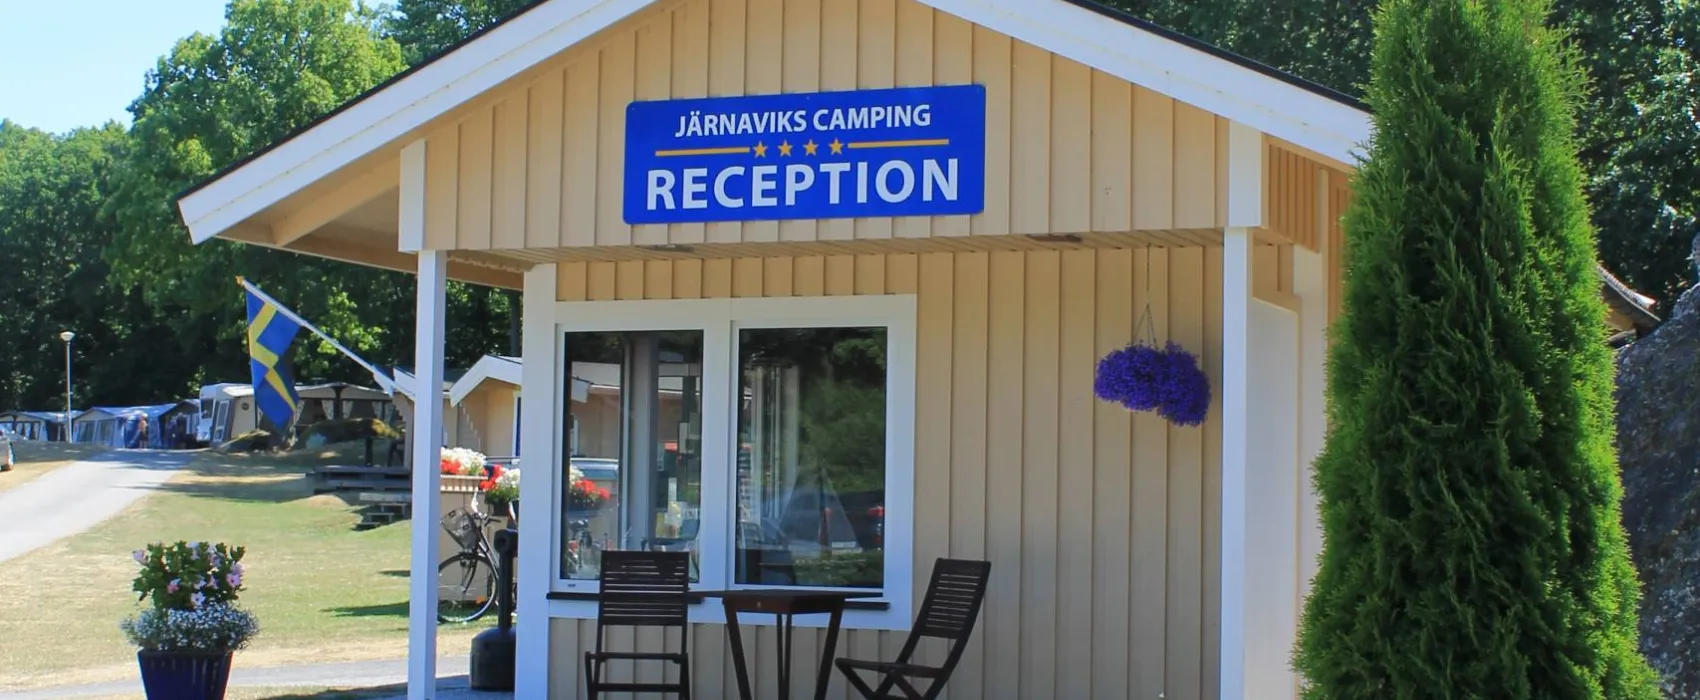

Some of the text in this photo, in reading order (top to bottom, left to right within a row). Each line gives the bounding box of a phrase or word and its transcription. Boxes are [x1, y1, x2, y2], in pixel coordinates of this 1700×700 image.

[675, 104, 931, 138] JÄRNAVIKS CAMPING
[646, 158, 958, 211] RECEPTION
